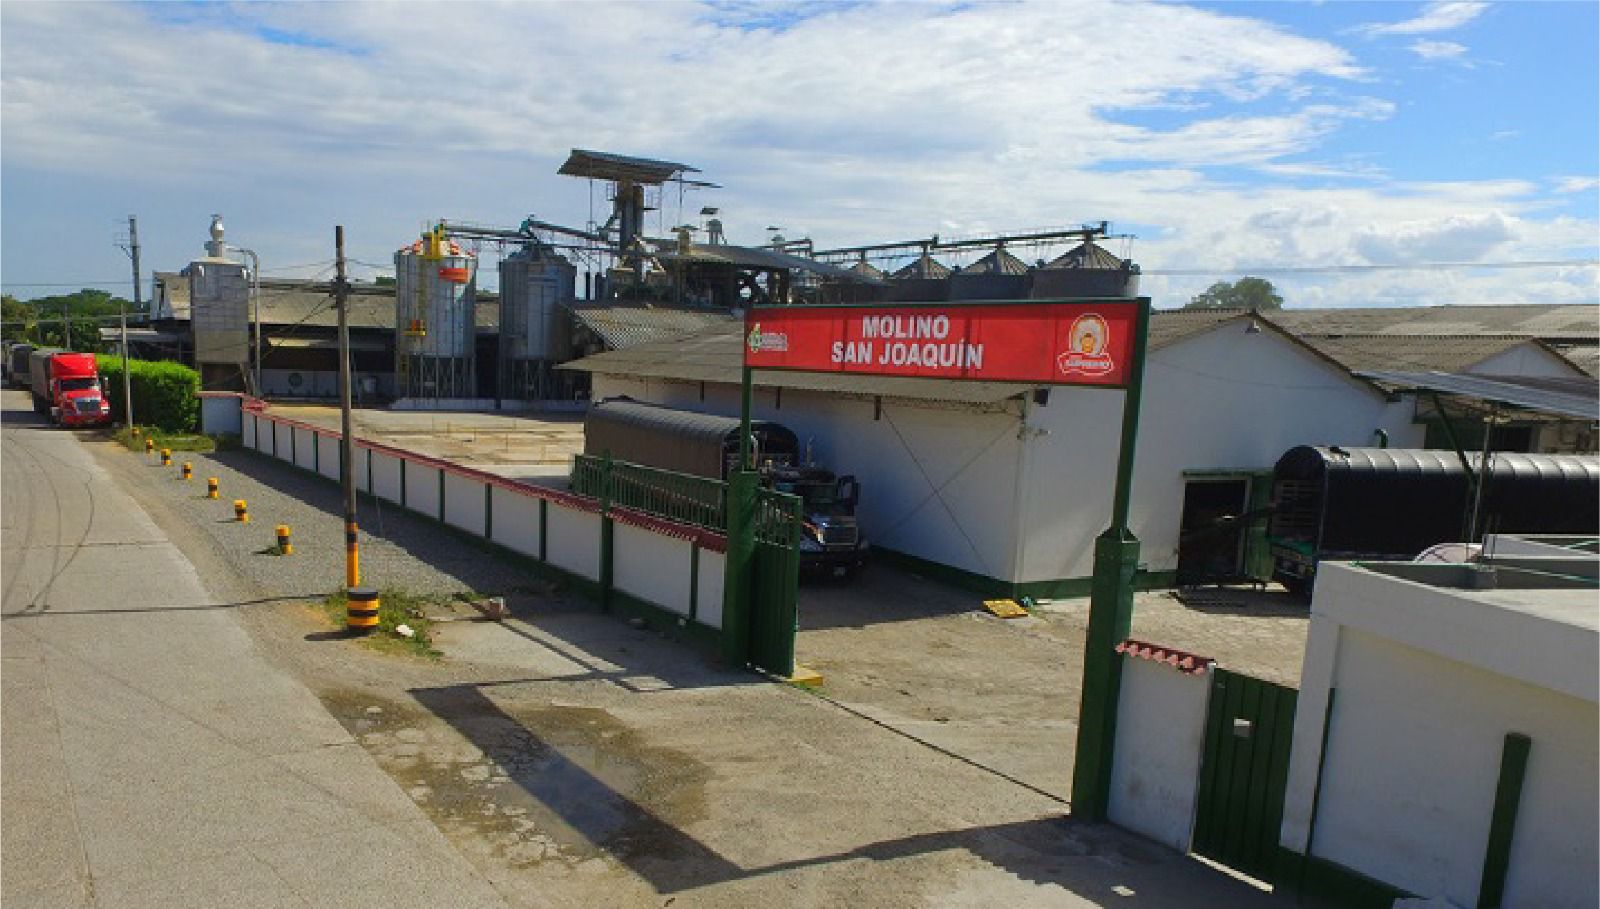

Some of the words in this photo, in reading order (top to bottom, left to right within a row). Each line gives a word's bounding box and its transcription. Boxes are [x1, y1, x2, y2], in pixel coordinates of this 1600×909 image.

[862, 315, 949, 339] MOLINO
[831, 341, 873, 364] SAN
[878, 338, 984, 370] JOAQUÍN
